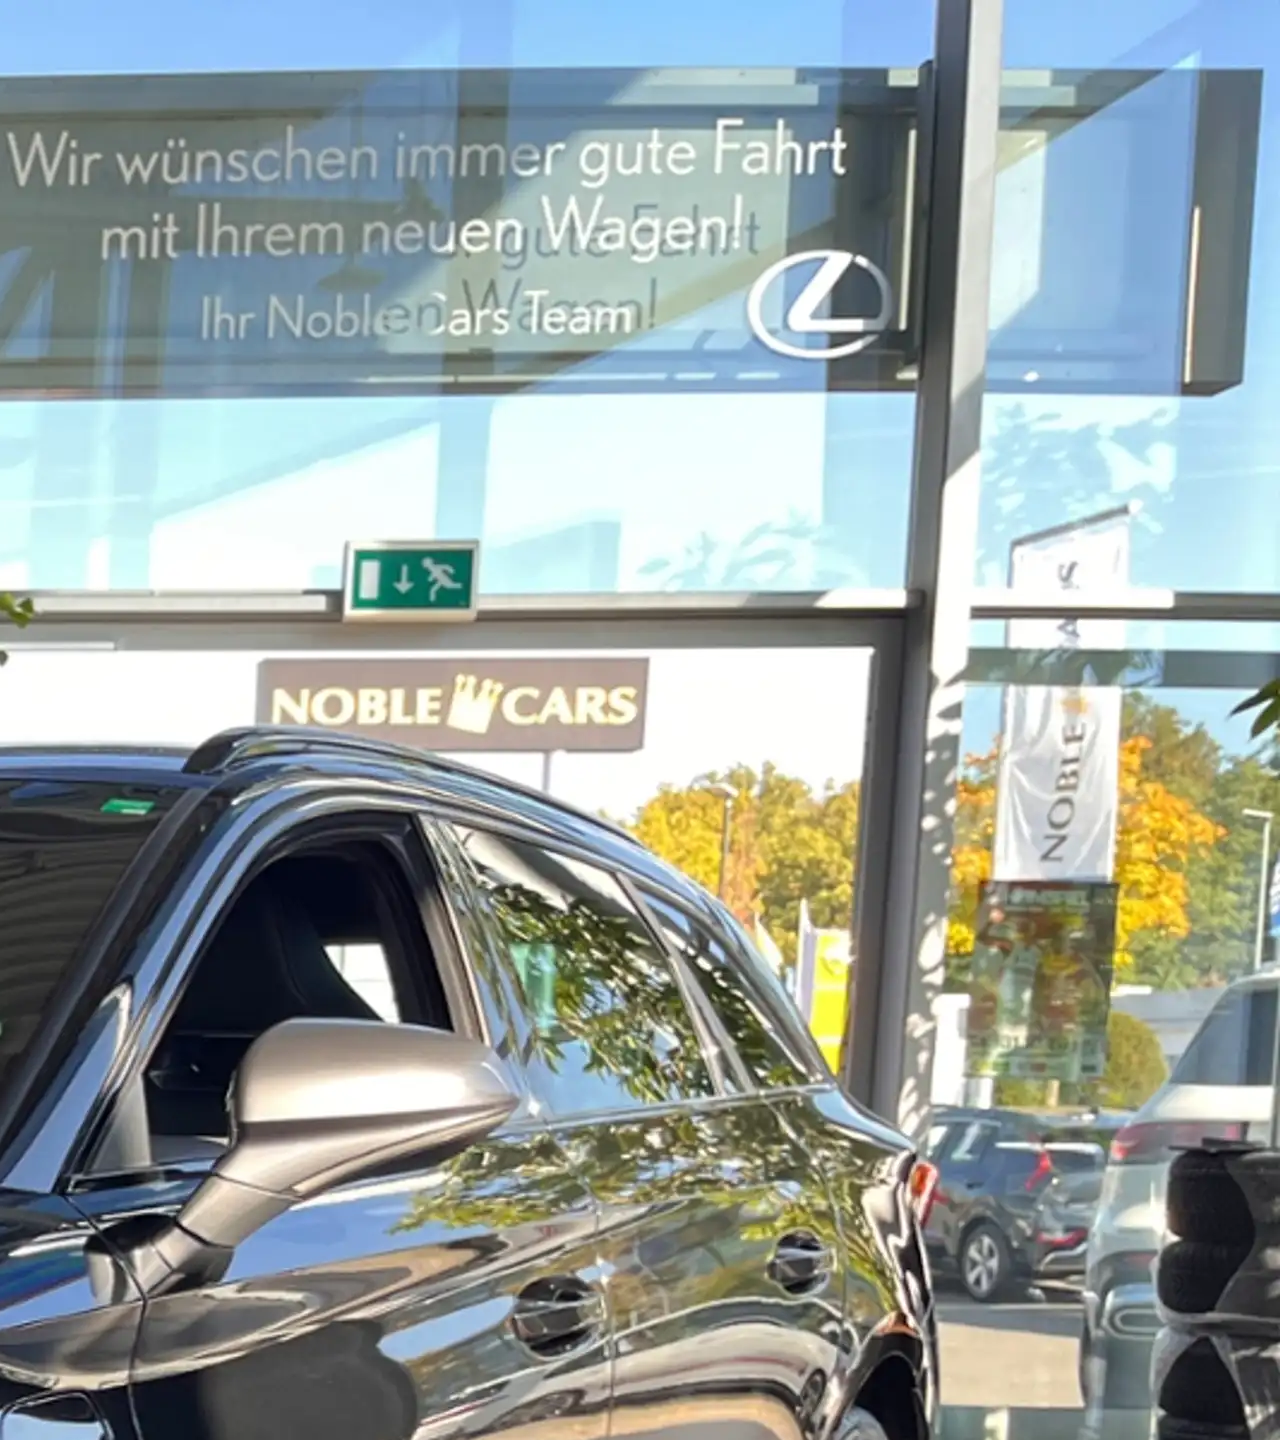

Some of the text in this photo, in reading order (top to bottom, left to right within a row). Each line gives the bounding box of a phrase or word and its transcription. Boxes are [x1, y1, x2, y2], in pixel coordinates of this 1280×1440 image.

[6, 117, 848, 189] Wir wünschen immer gute Fahrt
[100, 211, 180, 260] mit
[197, 200, 345, 258] Ihrem
[363, 215, 523, 255] neuen
[540, 194, 744, 263] Wagen!
[201, 294, 256, 341] Ihr
[268, 291, 404, 339] Noble
[523, 290, 632, 336] Team
[272, 685, 638, 727] NOBLE CARS
[1040, 722, 1088, 864] NOBLE
